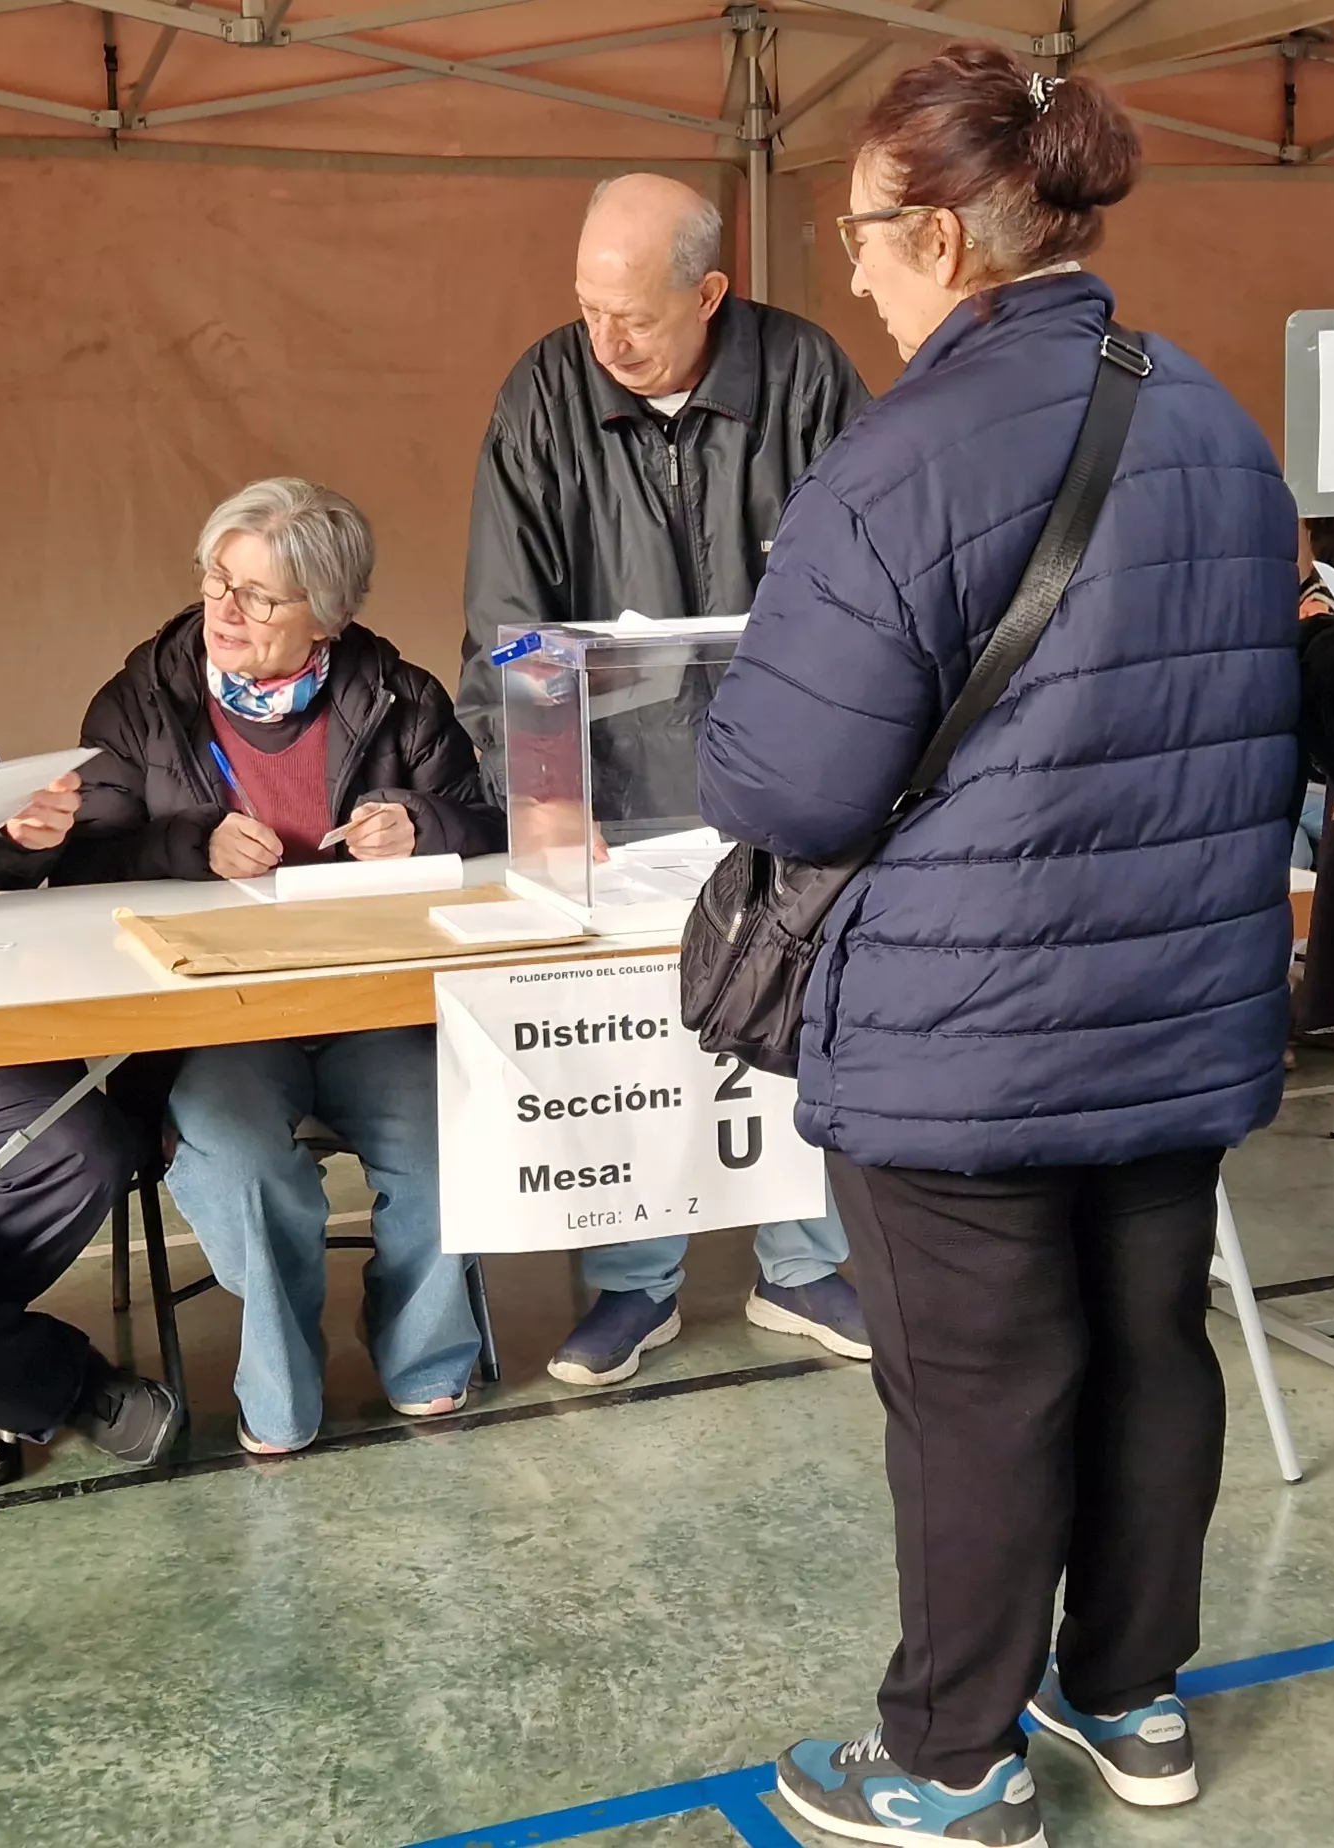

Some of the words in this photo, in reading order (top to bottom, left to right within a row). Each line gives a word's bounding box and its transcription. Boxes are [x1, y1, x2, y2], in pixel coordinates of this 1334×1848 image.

[509, 969, 594, 984] POLIDEPORTIVO
[596, 967, 616, 977] DEL
[618, 964, 664, 975] COLEGIO
[514, 1014, 669, 1051] Distrito:
[516, 1082, 682, 1123] Sección:
[713, 1053, 753, 1103] 2
[519, 1161, 632, 1194] Mesa:
[717, 1115, 762, 1170] U
[567, 1209, 622, 1230] Letra:
[634, 1204, 648, 1222] A
[688, 1197, 699, 1215] Z
